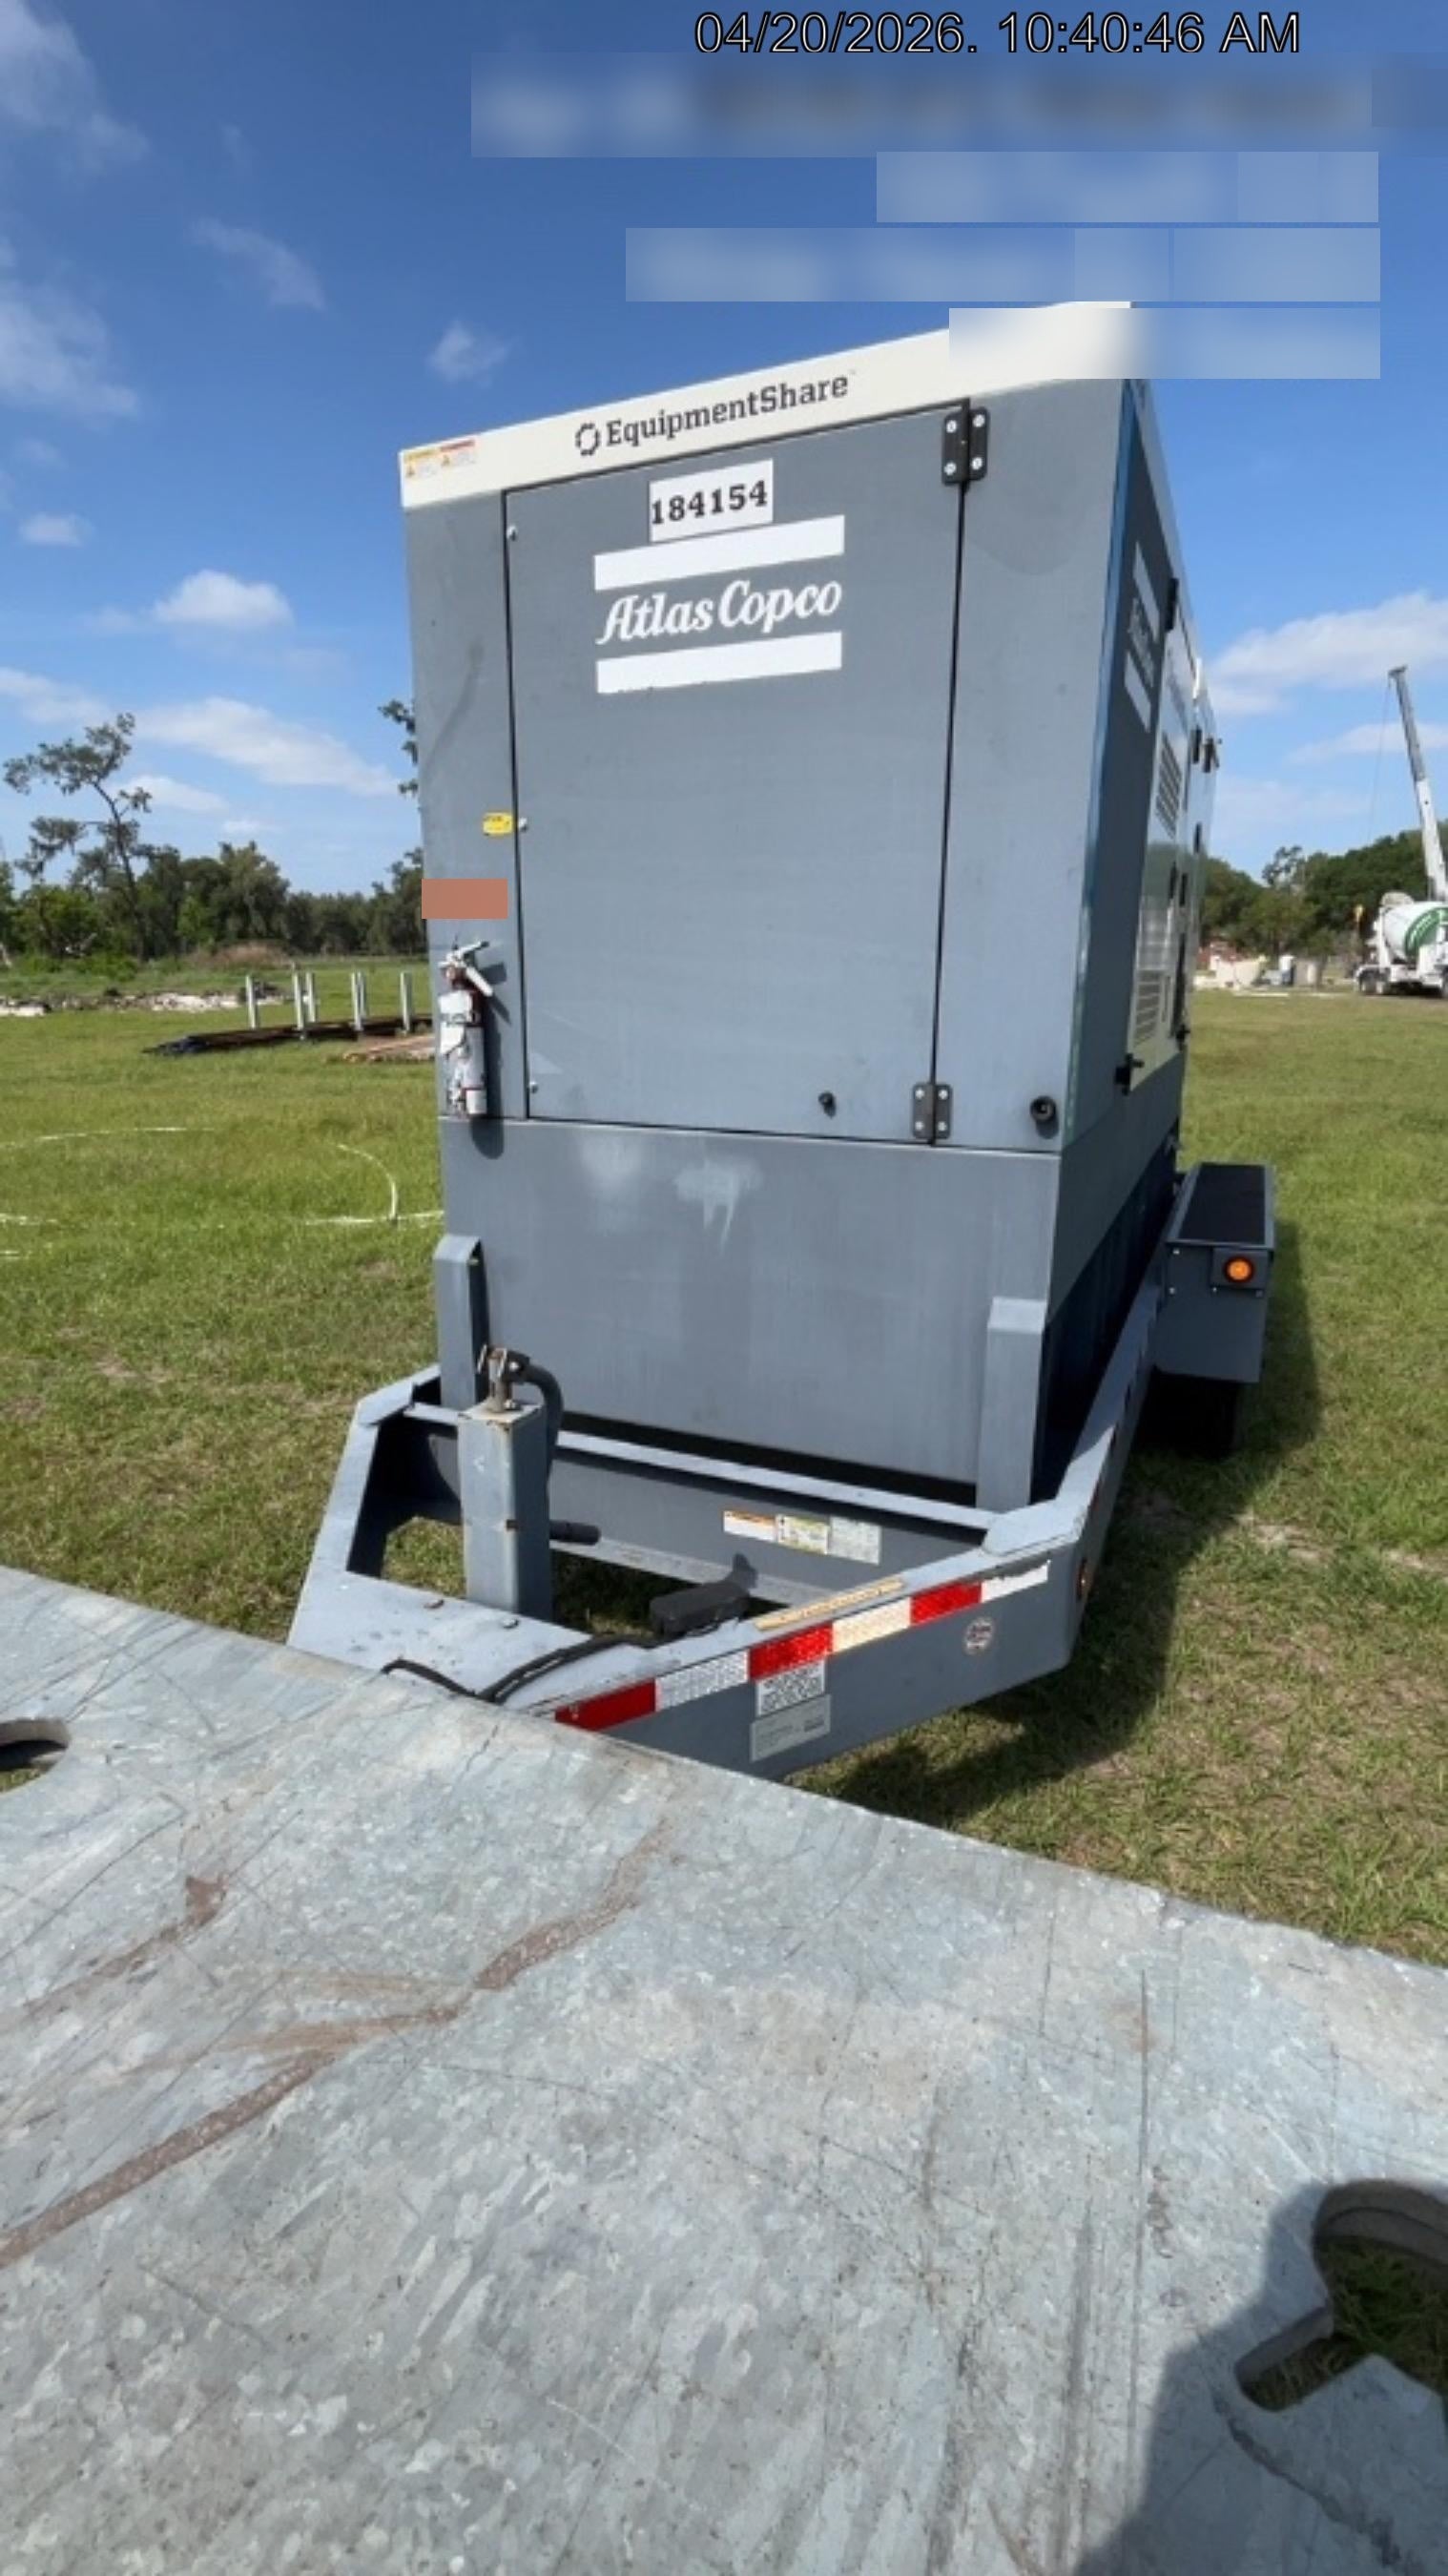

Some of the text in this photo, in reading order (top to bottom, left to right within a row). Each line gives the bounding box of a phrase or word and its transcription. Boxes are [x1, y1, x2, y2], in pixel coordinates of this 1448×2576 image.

[606, 375, 849, 447] EquipmentShare
[651, 480, 768, 526] 184154
[594, 580, 842, 646] Atlas Copco
